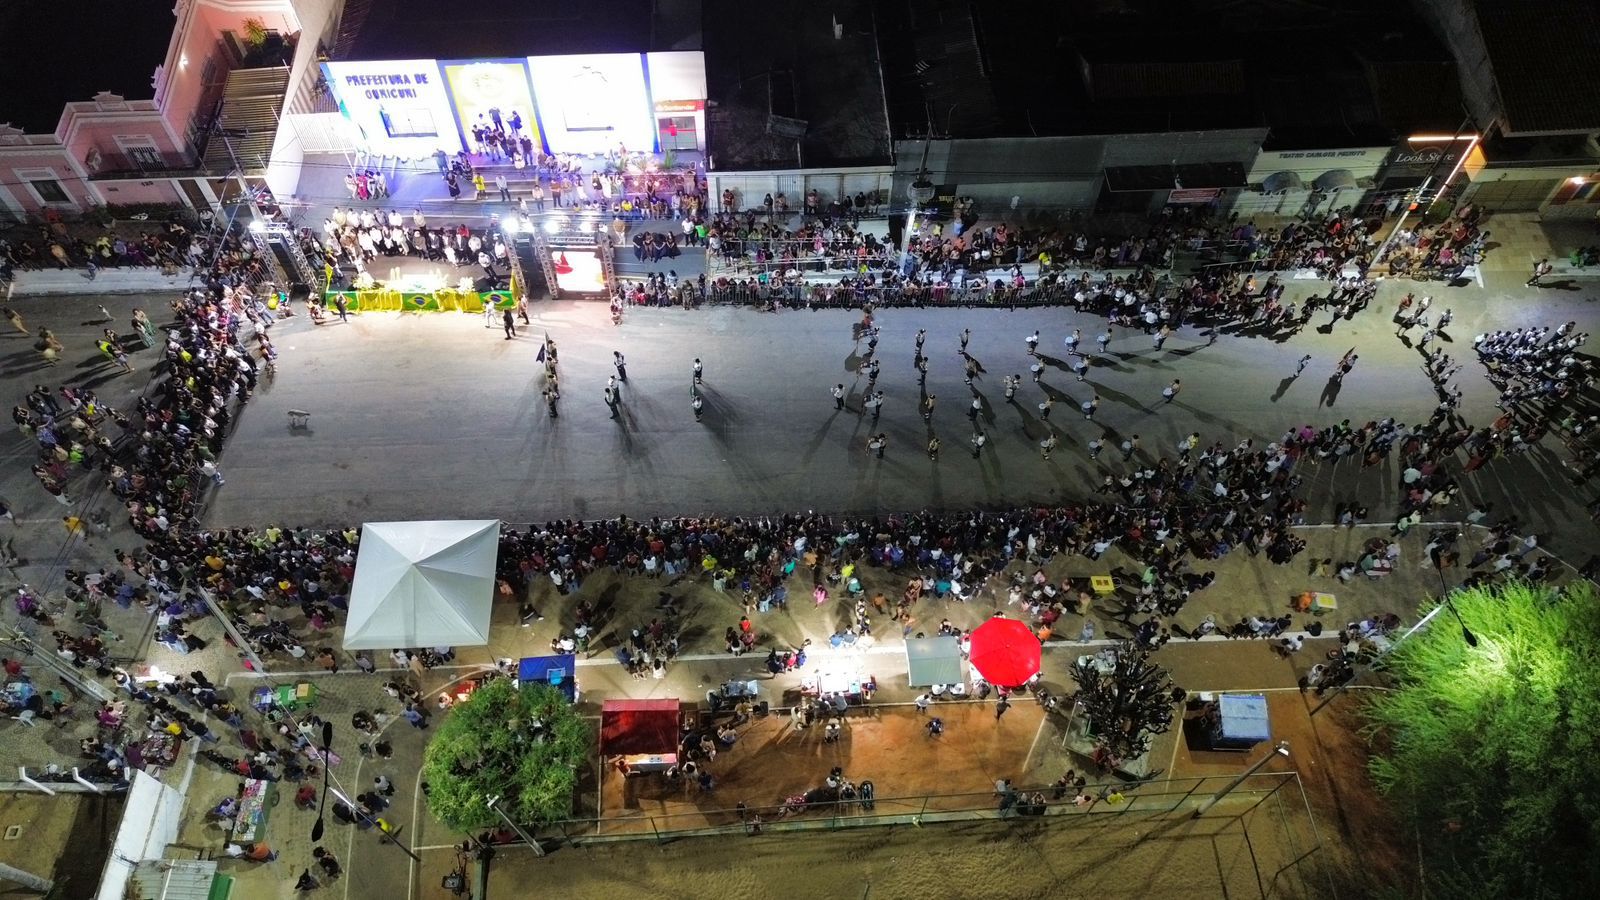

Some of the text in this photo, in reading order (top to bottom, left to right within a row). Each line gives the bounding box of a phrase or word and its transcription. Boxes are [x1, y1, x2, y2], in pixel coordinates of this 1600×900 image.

[345, 73, 429, 86] PREFEITURA DE
[365, 88, 417, 100] OURICURI
[1395, 153, 1423, 162] Look
